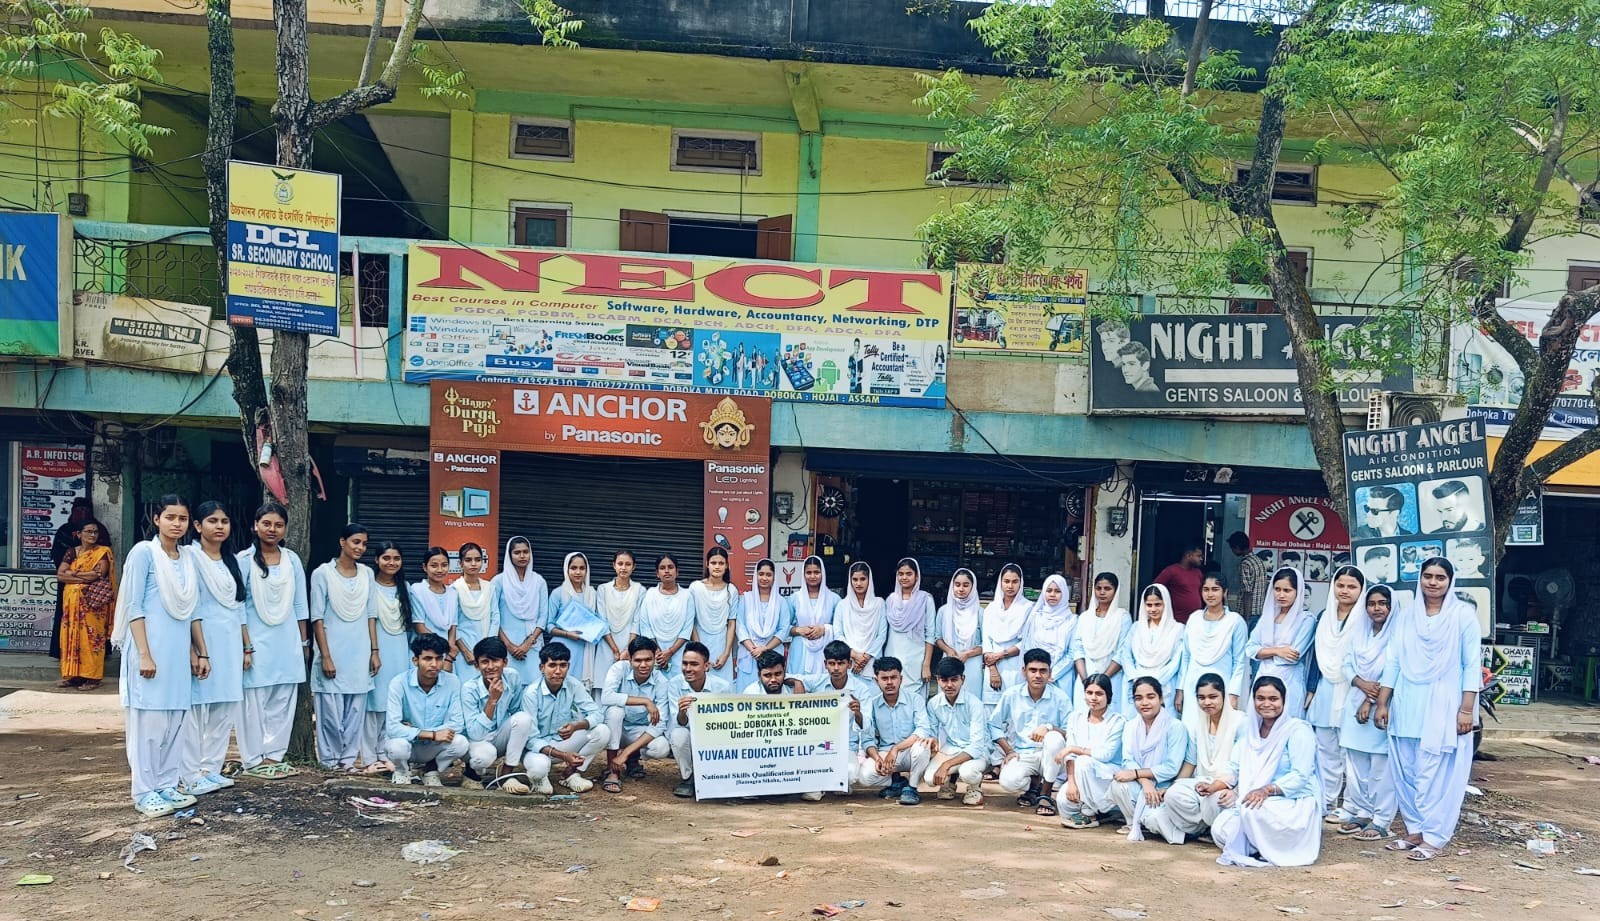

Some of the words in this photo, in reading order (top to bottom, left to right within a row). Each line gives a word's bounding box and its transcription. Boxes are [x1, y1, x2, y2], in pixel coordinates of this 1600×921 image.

[246, 224, 319, 251] DCL
[231, 243, 246, 261] SR.
[248, 246, 298, 267] SECONDARY
[300, 252, 334, 271] SCHOOL
[416, 246, 942, 315] NECT
[412, 294, 444, 302] Best
[449, 296, 507, 305] Courses
[512, 298, 525, 306] in
[529, 299, 599, 311] Computer
[608, 300, 669, 315] Software,
[674, 305, 741, 319] Hardware,
[746, 309, 827, 324] Accountancy,
[833, 314, 910, 328] Networking,
[916, 318, 939, 328] DTP
[114, 319, 163, 331] WESTERN
[429, 326, 480, 334] Windows
[128, 328, 162, 337] UNION
[892, 342, 900, 350] Be
[1150, 322, 1269, 363] NIGHT
[864, 345, 880, 358] Tally
[880, 352, 904, 362] Certified
[494, 358, 542, 368] Busy
[872, 362, 904, 372] Accountant
[877, 373, 894, 382] Tally
[764, 391, 802, 400] DOBOKA
[812, 393, 839, 402] HOJAI
[848, 394, 880, 404] ASSAM
[1165, 387, 1218, 402] GENTS
[1223, 387, 1290, 402] SALOON
[546, 392, 687, 422] ANCHOR
[443, 405, 500, 425] Durga
[462, 420, 496, 438] Puja
[544, 431, 557, 442] by
[562, 424, 662, 446] Panasonic
[1348, 431, 1408, 456] NIGHT
[1416, 421, 1484, 448] ANGEL
[26, 450, 42, 458] A.R.
[44, 450, 84, 460] INFOTECH
[446, 454, 496, 464] ANCHOR
[1368, 457, 1388, 465] AIR
[1394, 448, 1461, 462] CONDITION
[451, 465, 488, 473] Panasonic
[708, 462, 765, 474] Panasonic
[1351, 468, 1382, 481] GENTS
[1385, 463, 1424, 478] SALOON
[1426, 462, 1434, 474] &
[1437, 456, 1484, 472] PARLOUR
[716, 476, 738, 484] LED
[1254, 499, 1286, 523] NIGHT
[1289, 496, 1320, 505] ANGEL
[444, 520, 462, 528] Wiring
[1502, 647, 1531, 656] OKAYA
[1500, 676, 1529, 684] OKAYA
[697, 702, 734, 714] HANDS
[737, 702, 752, 712] ON
[756, 701, 786, 710] SKILL
[789, 698, 838, 709] TRAINING
[706, 722, 742, 731] SCHOOL:
[744, 720, 778, 729] DOBOKA
[779, 718, 796, 727] H.S.
[798, 716, 831, 726] SCHOOL
[730, 730, 754, 739] Under
[756, 728, 783, 738] IT/ITeS
[785, 727, 808, 736] Trade
[698, 748, 738, 761] YUVAAN
[741, 746, 794, 760] EDUCATIVE
[797, 744, 815, 756] LLP
[752, 770, 794, 779] Qualification
[796, 767, 835, 775] Framework
